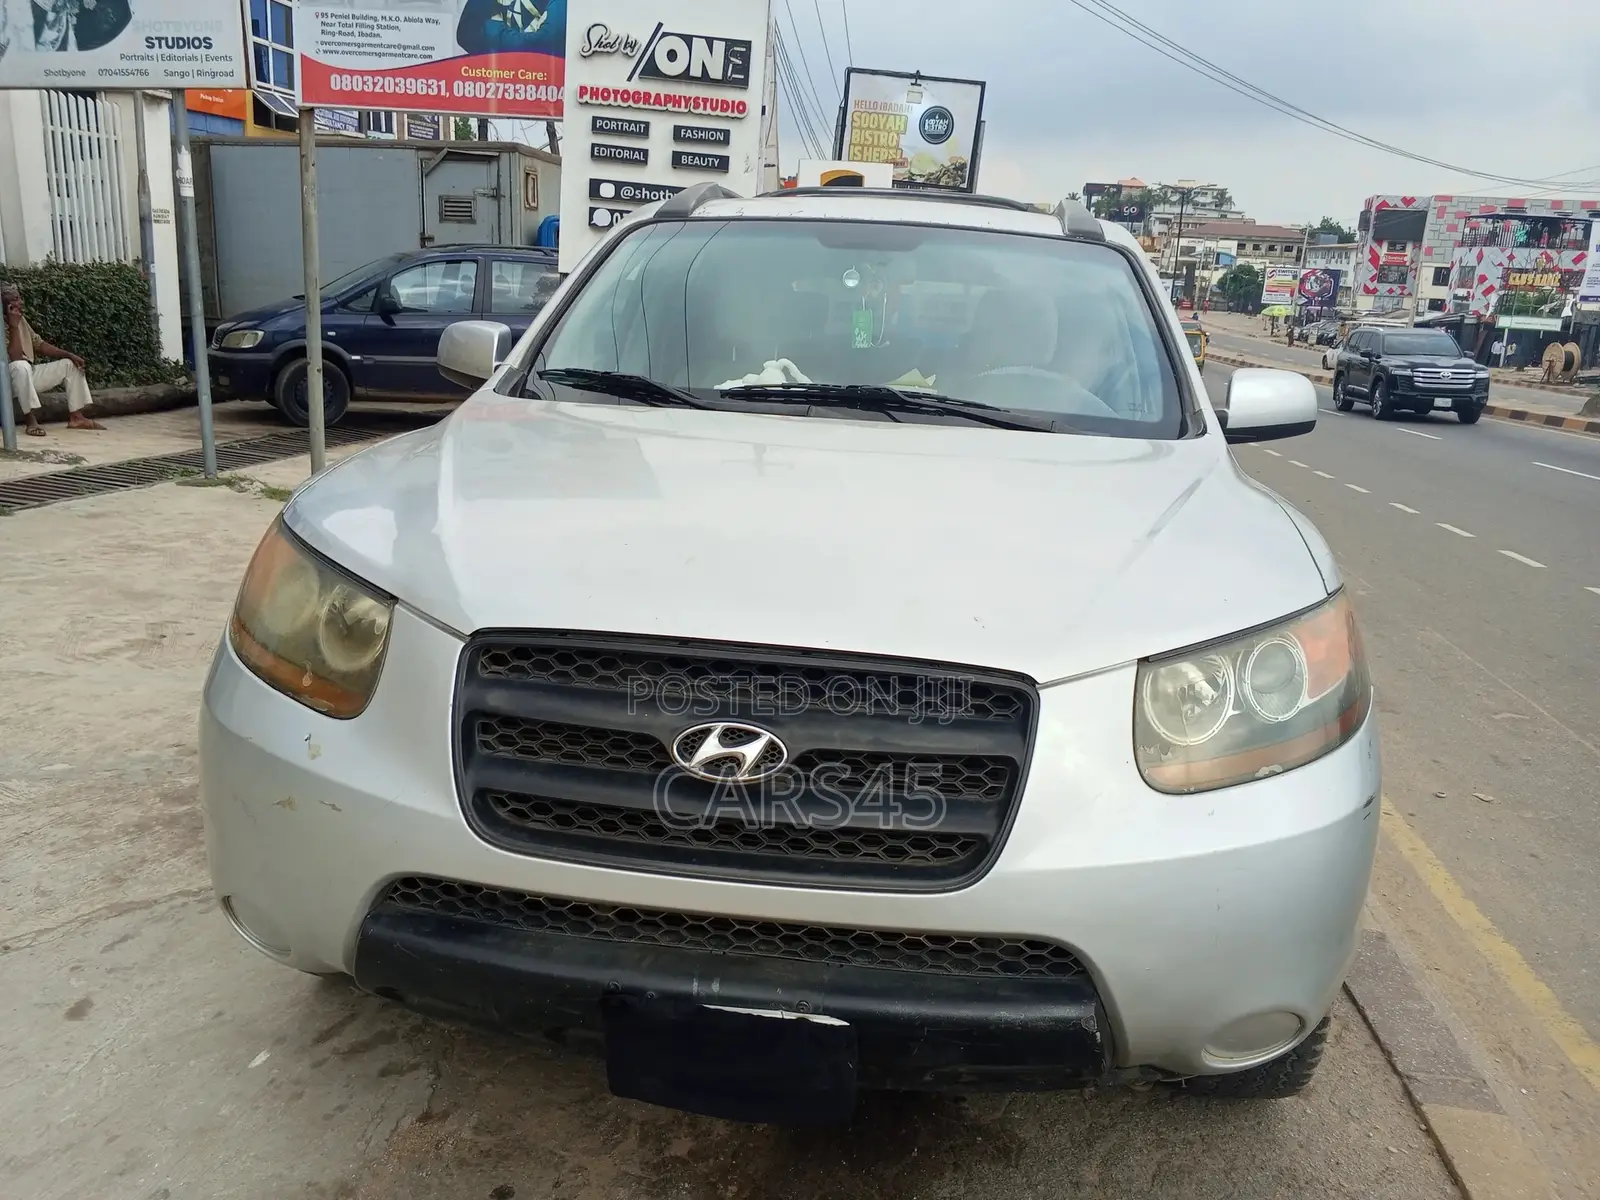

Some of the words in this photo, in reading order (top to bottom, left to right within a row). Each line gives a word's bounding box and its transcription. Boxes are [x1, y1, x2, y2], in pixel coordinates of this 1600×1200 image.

[330, 12, 350, 20] Peniel
[351, 13, 380, 22] Building,
[321, 20, 336, 28] Near
[338, 21, 354, 29] Total
[355, 22, 375, 31] Filling
[145, 36, 213, 49] STUDIOS
[581, 23, 620, 56] Shot
[623, 33, 640, 56] by
[120, 53, 155, 61] Portraits
[160, 53, 199, 62] Editorials
[205, 54, 233, 62] Events
[97, 68, 149, 77] 07041554766
[163, 69, 190, 79] Sango
[196, 69, 235, 79] Ringroad
[461, 66, 515, 80] Customer
[518, 69, 547, 80] Care:
[330, 73, 450, 98] 08032039631,
[854, 99, 878, 111] HELLO
[852, 111, 907, 132] SOOYAH
[596, 119, 646, 133] PORTRAIT
[681, 129, 724, 141] FASHION
[851, 128, 898, 148] BISTRO
[594, 147, 646, 161] EDITORIAL
[681, 155, 720, 168] BEAUTY
